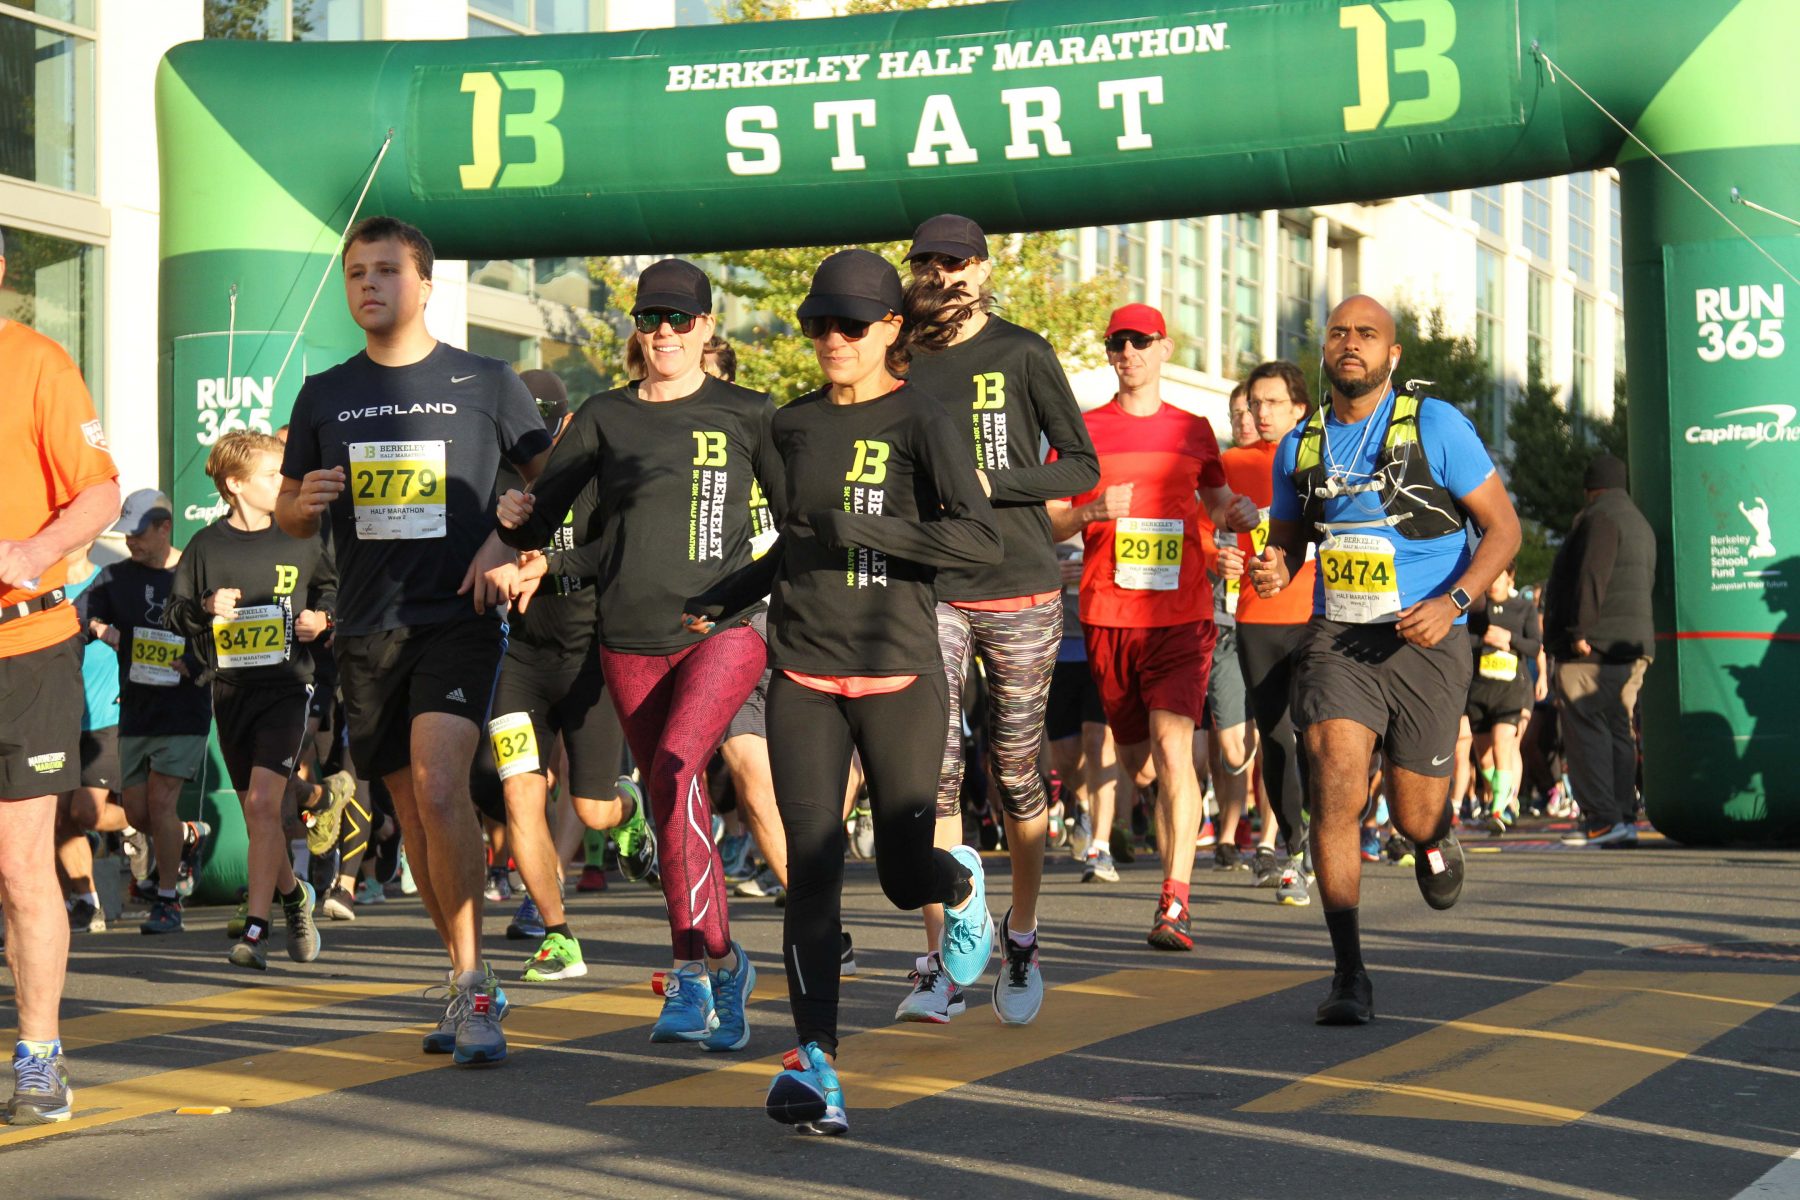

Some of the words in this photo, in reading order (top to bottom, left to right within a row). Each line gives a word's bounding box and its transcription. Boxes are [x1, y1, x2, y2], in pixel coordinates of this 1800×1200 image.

[665, 54, 870, 92] BERKELEY
[877, 46, 984, 80] HALF
[725, 76, 1164, 177] START
[1696, 283, 1785, 323] RUN
[1697, 319, 1786, 362] 365
[196, 376, 273, 410] RUN
[338, 402, 457, 422] OVERLAND
[982, 413, 992, 440] HALF
[380, 444, 425, 453] BERKELEY
[994, 413, 1010, 470] BERKE
[357, 469, 437, 499] 2779
[692, 470, 700, 480] 5K
[702, 470, 712, 499] HALF
[691, 483, 699, 496] 10K
[844, 486, 851, 498] 5K
[690, 500, 698, 519] HALF
[843, 501, 851, 513] 10
[854, 487, 864, 515] HAL
[710, 471, 728, 560] BERKELEY
[688, 519, 697, 561] MARATHON
[1121, 538, 1178, 561] 2918
[1343, 536, 1380, 545] BERKELEY
[1710, 535, 1750, 546] Berkeley
[1711, 546, 1740, 556] Public
[1711, 556, 1749, 567] Schools
[1326, 557, 1390, 586] 3474
[1711, 567, 1735, 578] Fund
[1349, 593, 1380, 601] MARATHON
[219, 625, 279, 650] 3472
[135, 643, 178, 663] 3291
[446, 694, 467, 703] adidas
